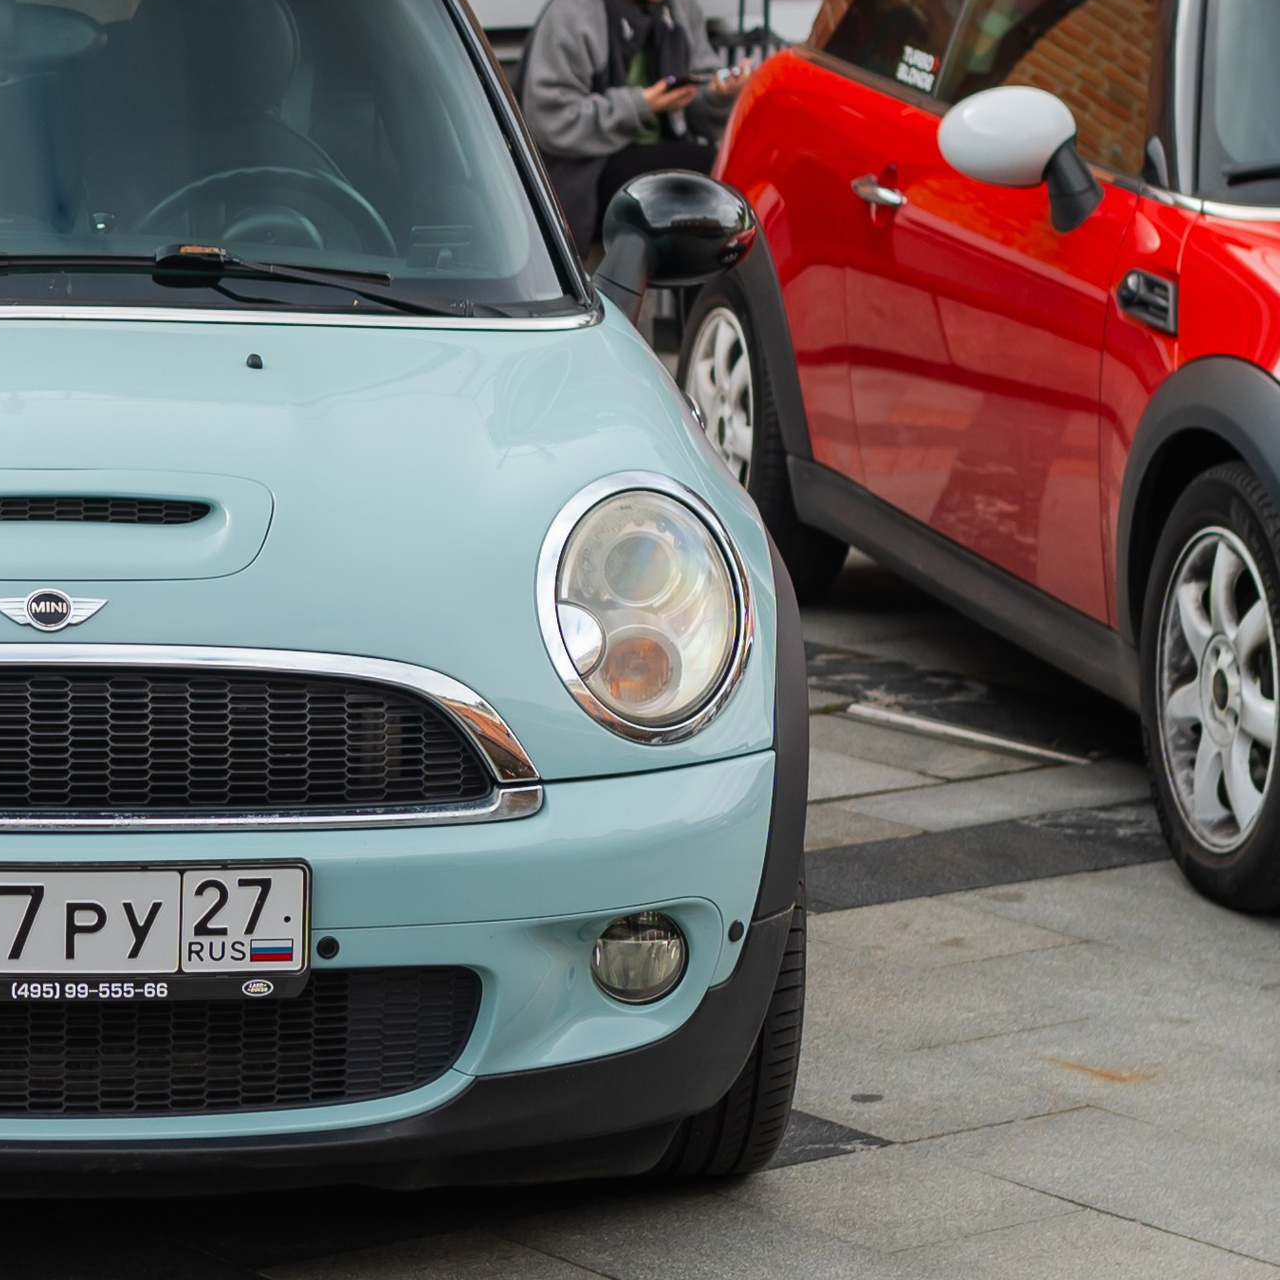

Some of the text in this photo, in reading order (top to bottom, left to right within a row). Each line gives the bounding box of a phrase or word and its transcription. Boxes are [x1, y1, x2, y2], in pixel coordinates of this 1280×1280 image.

[31, 601, 68, 614] MINI
[192, 877, 273, 937] 27
[187, 941, 247, 962] RUS
[10, 982, 169, 1000] (495) 99-555-66
